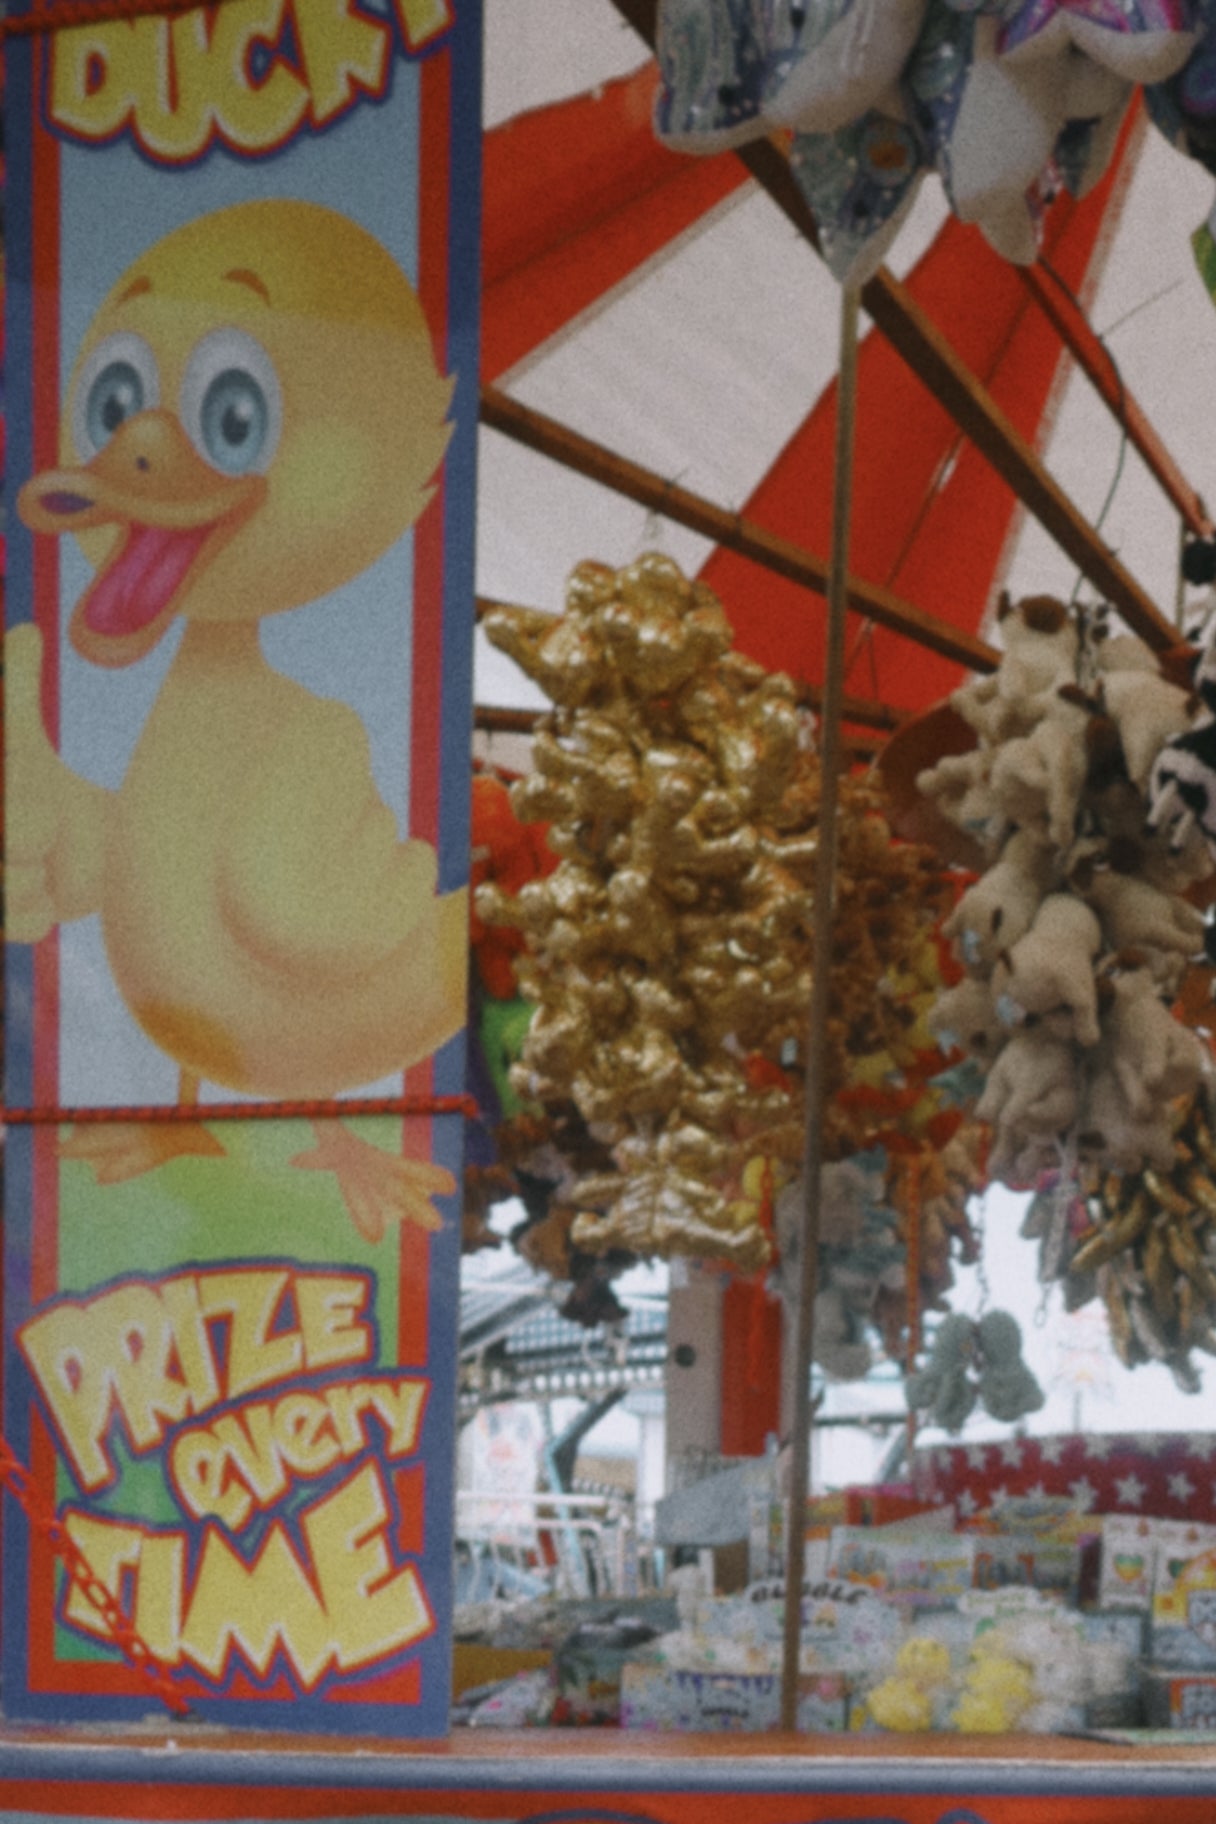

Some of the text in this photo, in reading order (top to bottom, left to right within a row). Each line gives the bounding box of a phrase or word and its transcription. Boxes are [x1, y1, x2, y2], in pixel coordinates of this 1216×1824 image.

[17, 1264, 374, 1494] PRIZE
[165, 1378, 430, 1532] every
[62, 1457, 436, 1691] TIME
